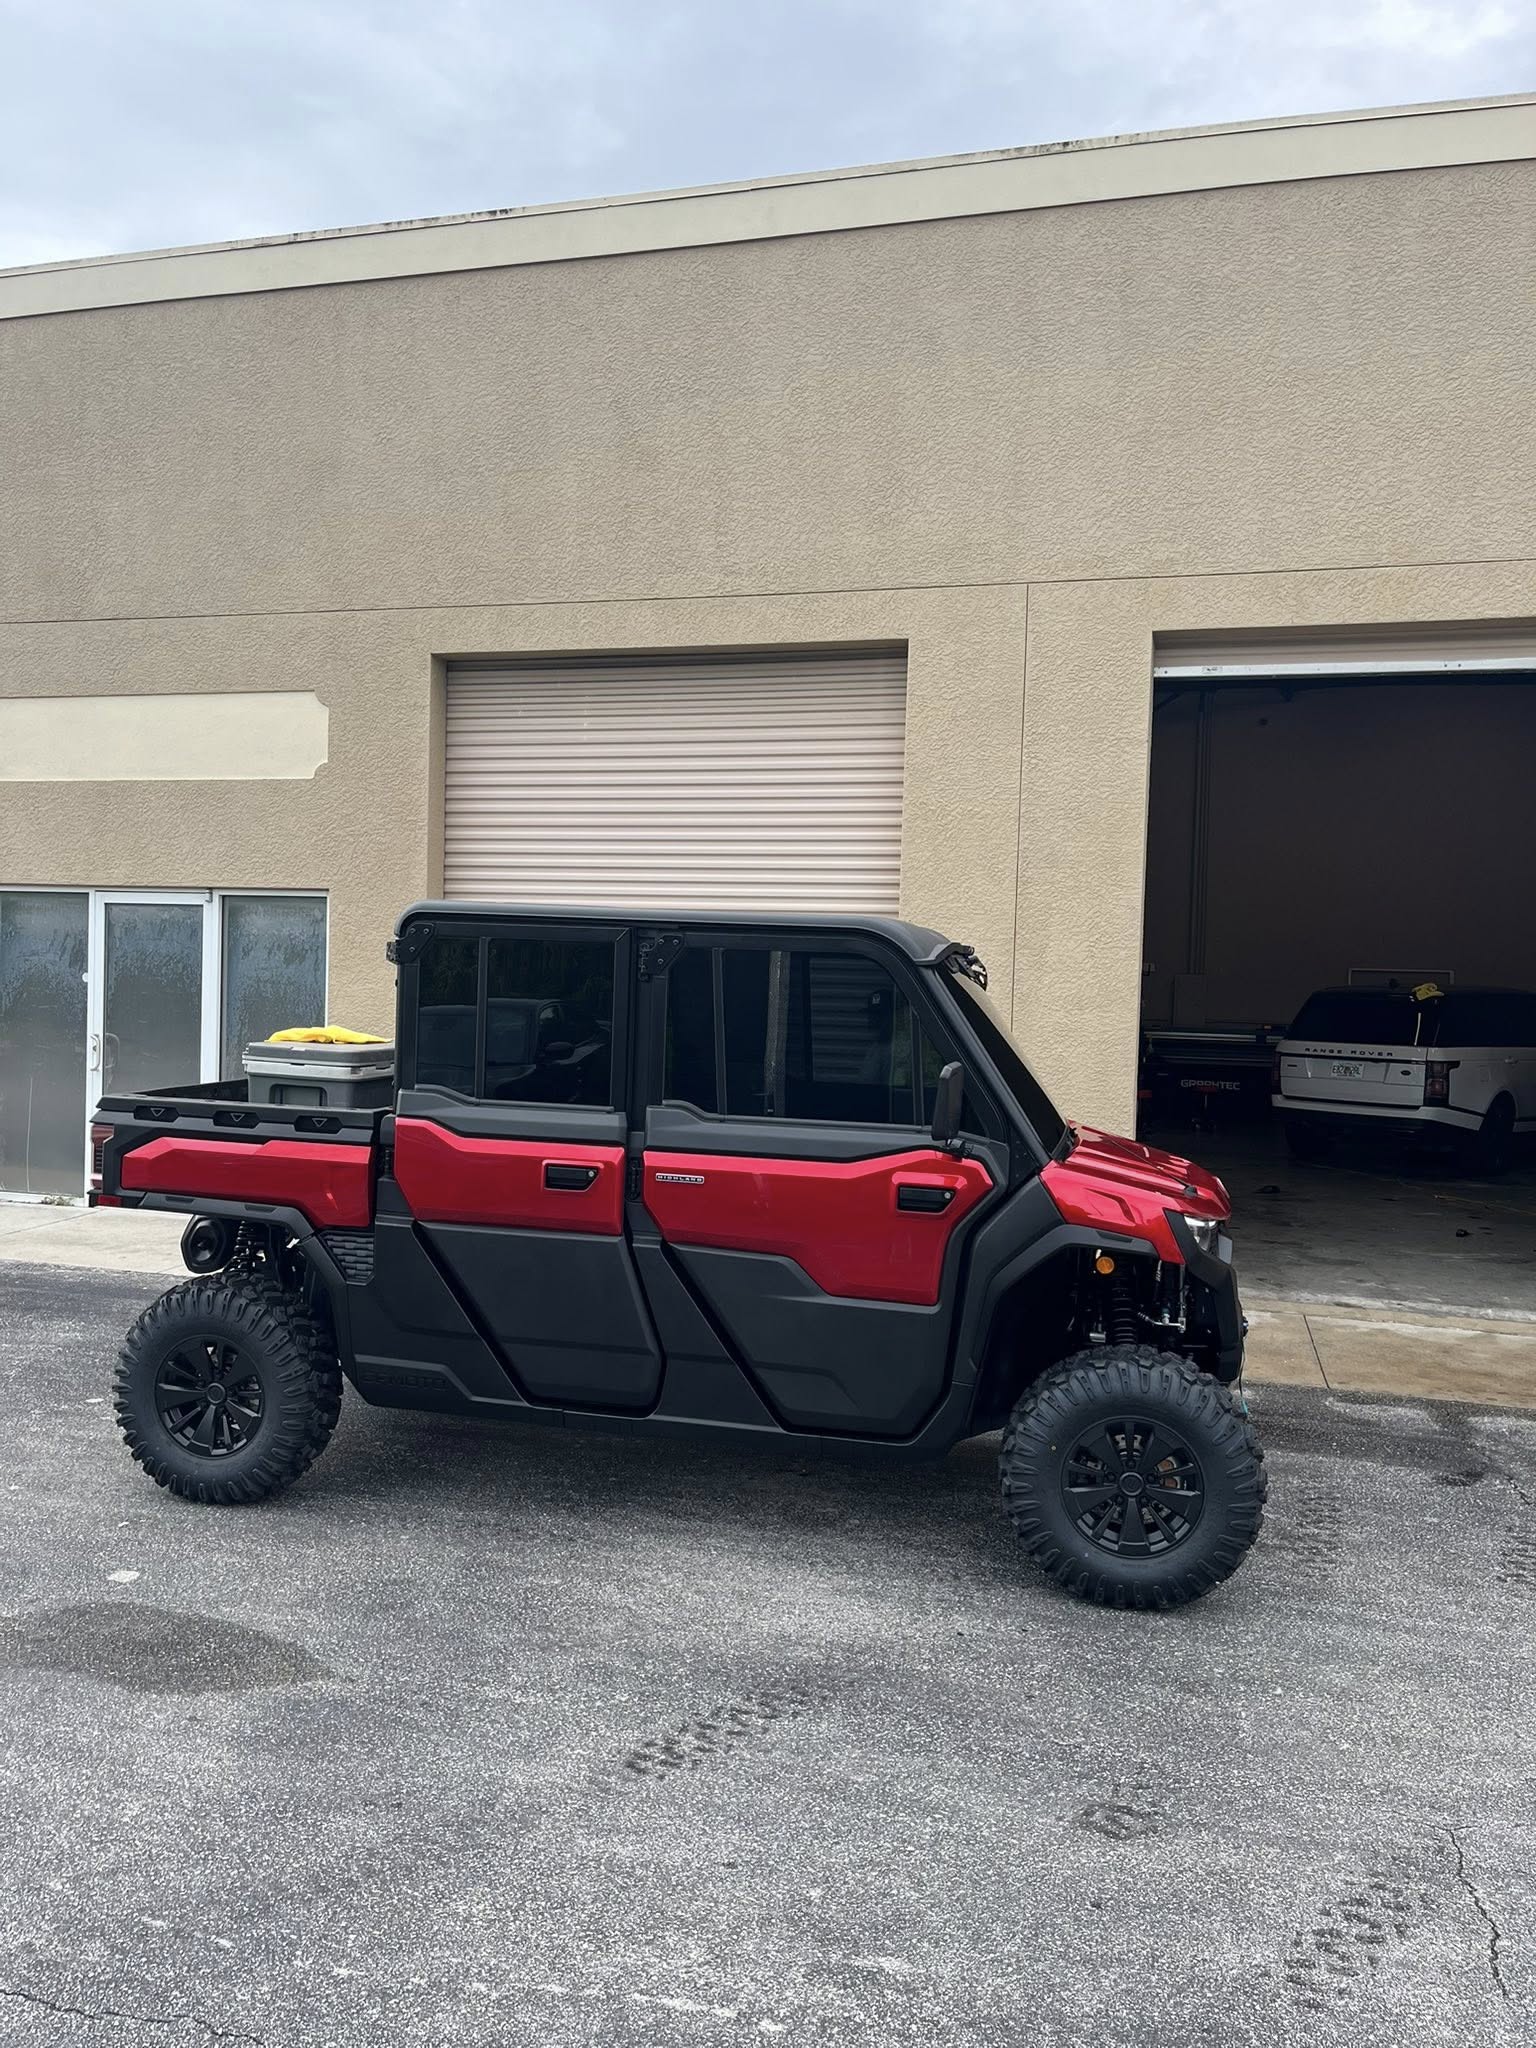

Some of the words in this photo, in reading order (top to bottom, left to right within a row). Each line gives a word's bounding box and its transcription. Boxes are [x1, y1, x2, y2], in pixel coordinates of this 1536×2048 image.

[1304, 1047, 1343, 1055] RANGE
[1350, 1049, 1394, 1057] ROVER
[657, 1175, 702, 1183] HIGHLAND
